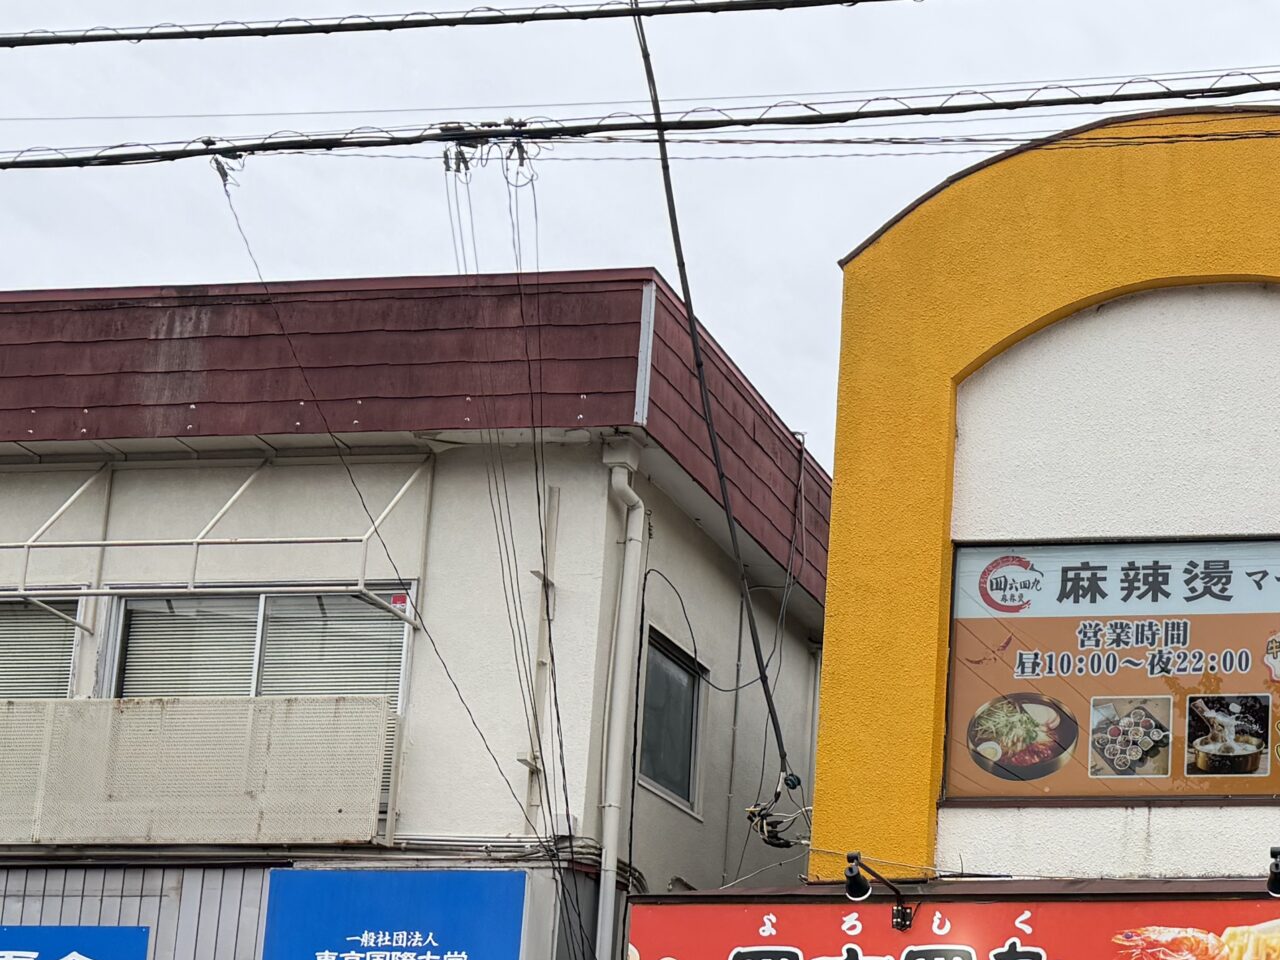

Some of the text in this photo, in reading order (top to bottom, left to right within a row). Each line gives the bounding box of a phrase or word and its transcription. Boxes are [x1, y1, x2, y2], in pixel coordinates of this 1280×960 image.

[1056, 560, 1234, 604] 麻辣燙
[1076, 620, 1190, 649] 営業時間
[346, 930, 439, 948] 一般社団法人
